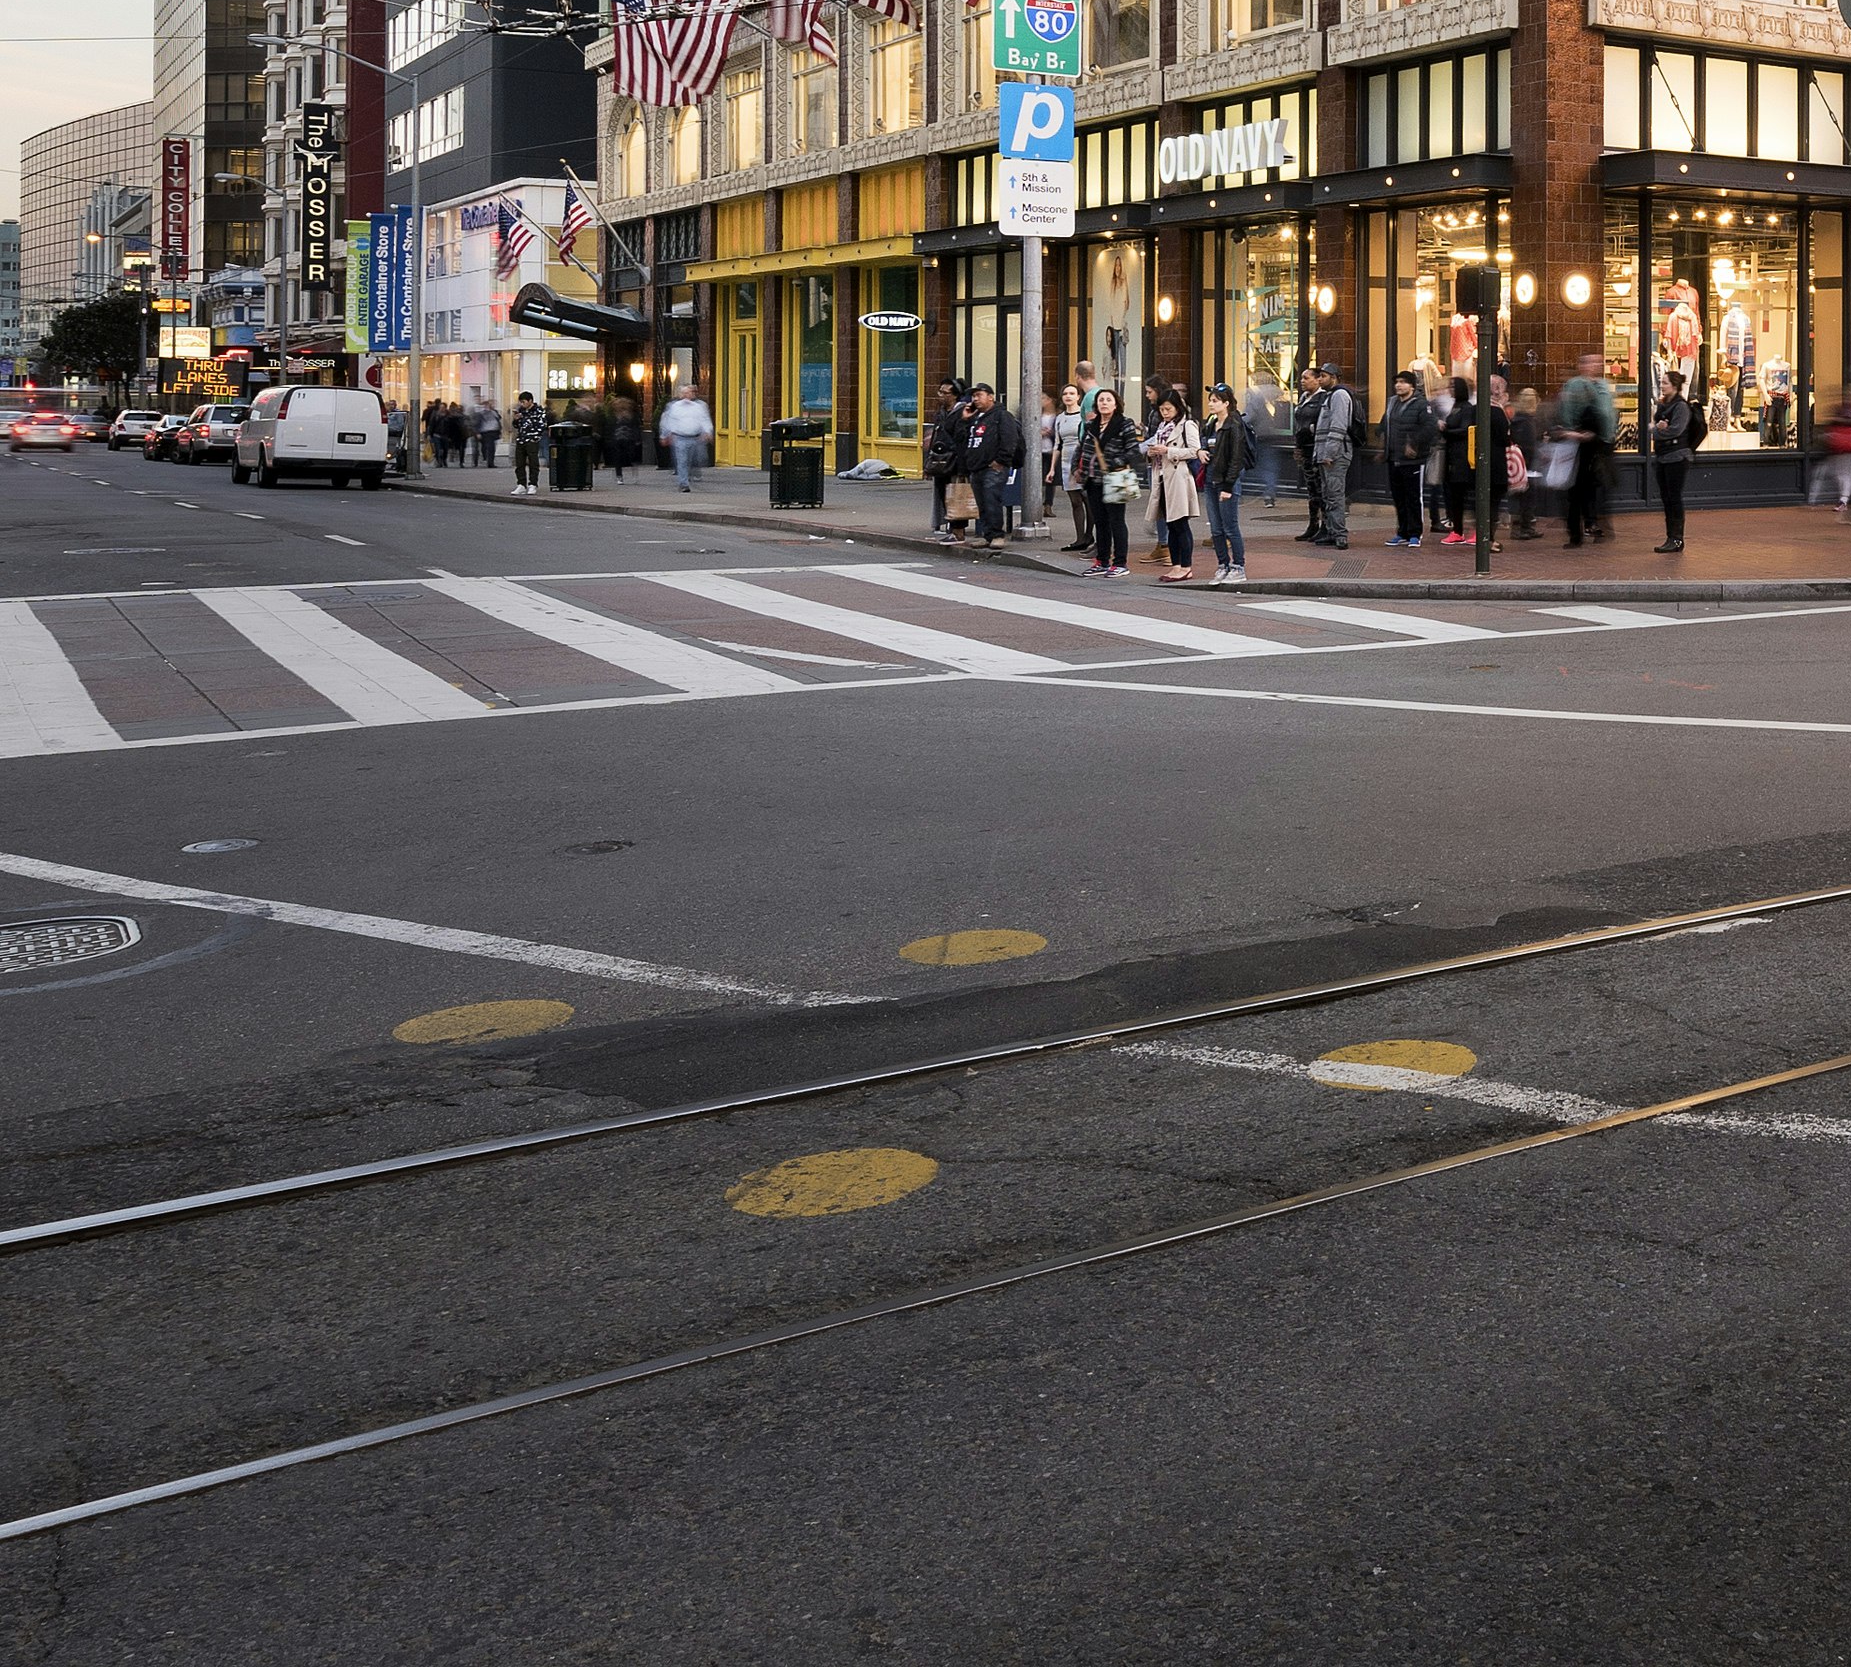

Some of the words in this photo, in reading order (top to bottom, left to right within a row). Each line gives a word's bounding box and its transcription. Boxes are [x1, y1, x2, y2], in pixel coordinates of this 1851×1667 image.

[1035, 0, 1066, 10] INTERSTATE
[1034, 10, 1067, 35] 80
[1008, 47, 1039, 69] Bay
[1046, 51, 1066, 69] Br
[307, 112, 328, 148] The
[1159, 133, 1206, 184] OLD
[1210, 118, 1284, 177] NAVY
[169, 143, 185, 187] CITY
[1022, 172, 1038, 183] 5th
[1041, 173, 1049, 183] &
[1022, 183, 1062, 194] Mission
[1022, 203, 1068, 215] Moscone
[1022, 213, 1057, 224] Center
[168, 191, 185, 269] COLLE
[375, 225, 389, 258] Store
[402, 217, 413, 252] Store
[347, 254, 357, 290] PICKUP
[359, 253, 369, 295] GARAGE
[374, 259, 388, 319] Container
[400, 252, 412, 316] Container
[346, 292, 357, 325] ORDER
[358, 297, 368, 327] ENTER
[374, 320, 387, 343] The
[401, 317, 412, 340] The
[868, 316, 888, 327] OLD
[888, 316, 916, 327] NAVY
[1260, 337, 1285, 353] SALE
[184, 359, 224, 372] THRU
[303, 359, 336, 367] OSSER
[177, 370, 228, 384] LANES
[162, 382, 194, 395] LFT
[202, 384, 240, 397] SIDE
